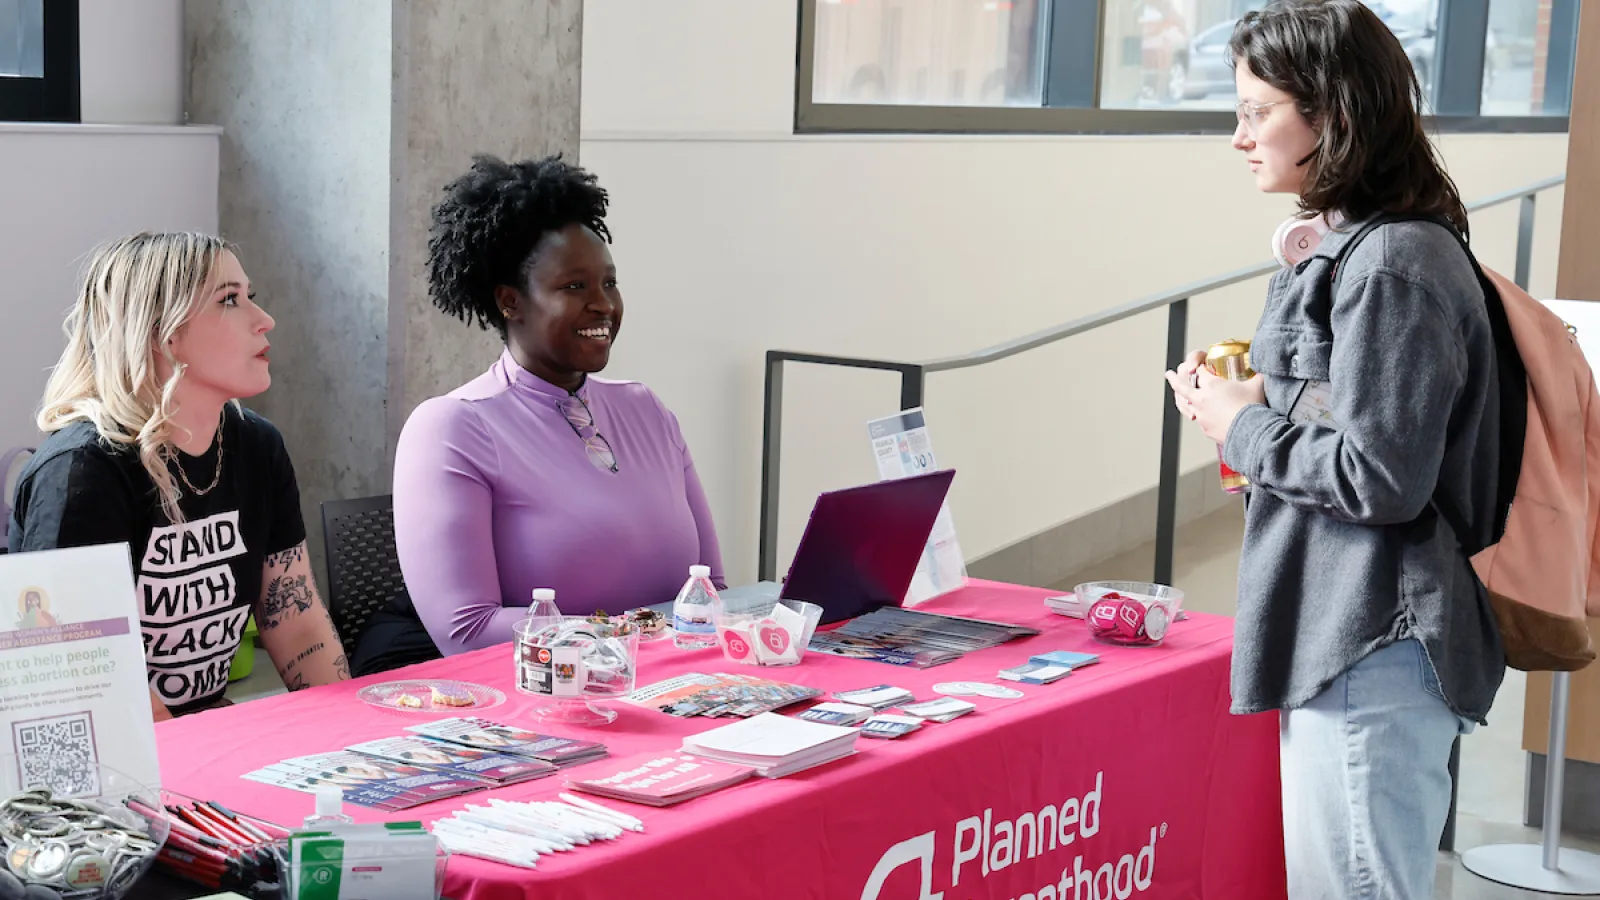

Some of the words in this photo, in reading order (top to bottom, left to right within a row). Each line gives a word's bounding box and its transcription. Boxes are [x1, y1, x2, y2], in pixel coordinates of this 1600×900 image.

[148, 520, 236, 566] STAND
[143, 572, 230, 618] WITH
[14, 634, 61, 648] ASSISTANCE
[63, 629, 102, 641] PROGRAM
[16, 658, 30, 669] to
[33, 652, 62, 667] help
[67, 646, 110, 664] people
[21, 667, 79, 685] abortion
[82, 660, 116, 676] care?
[84, 682, 100, 691] drive
[147, 659, 232, 698] OME
[952, 771, 1103, 888] Planned
